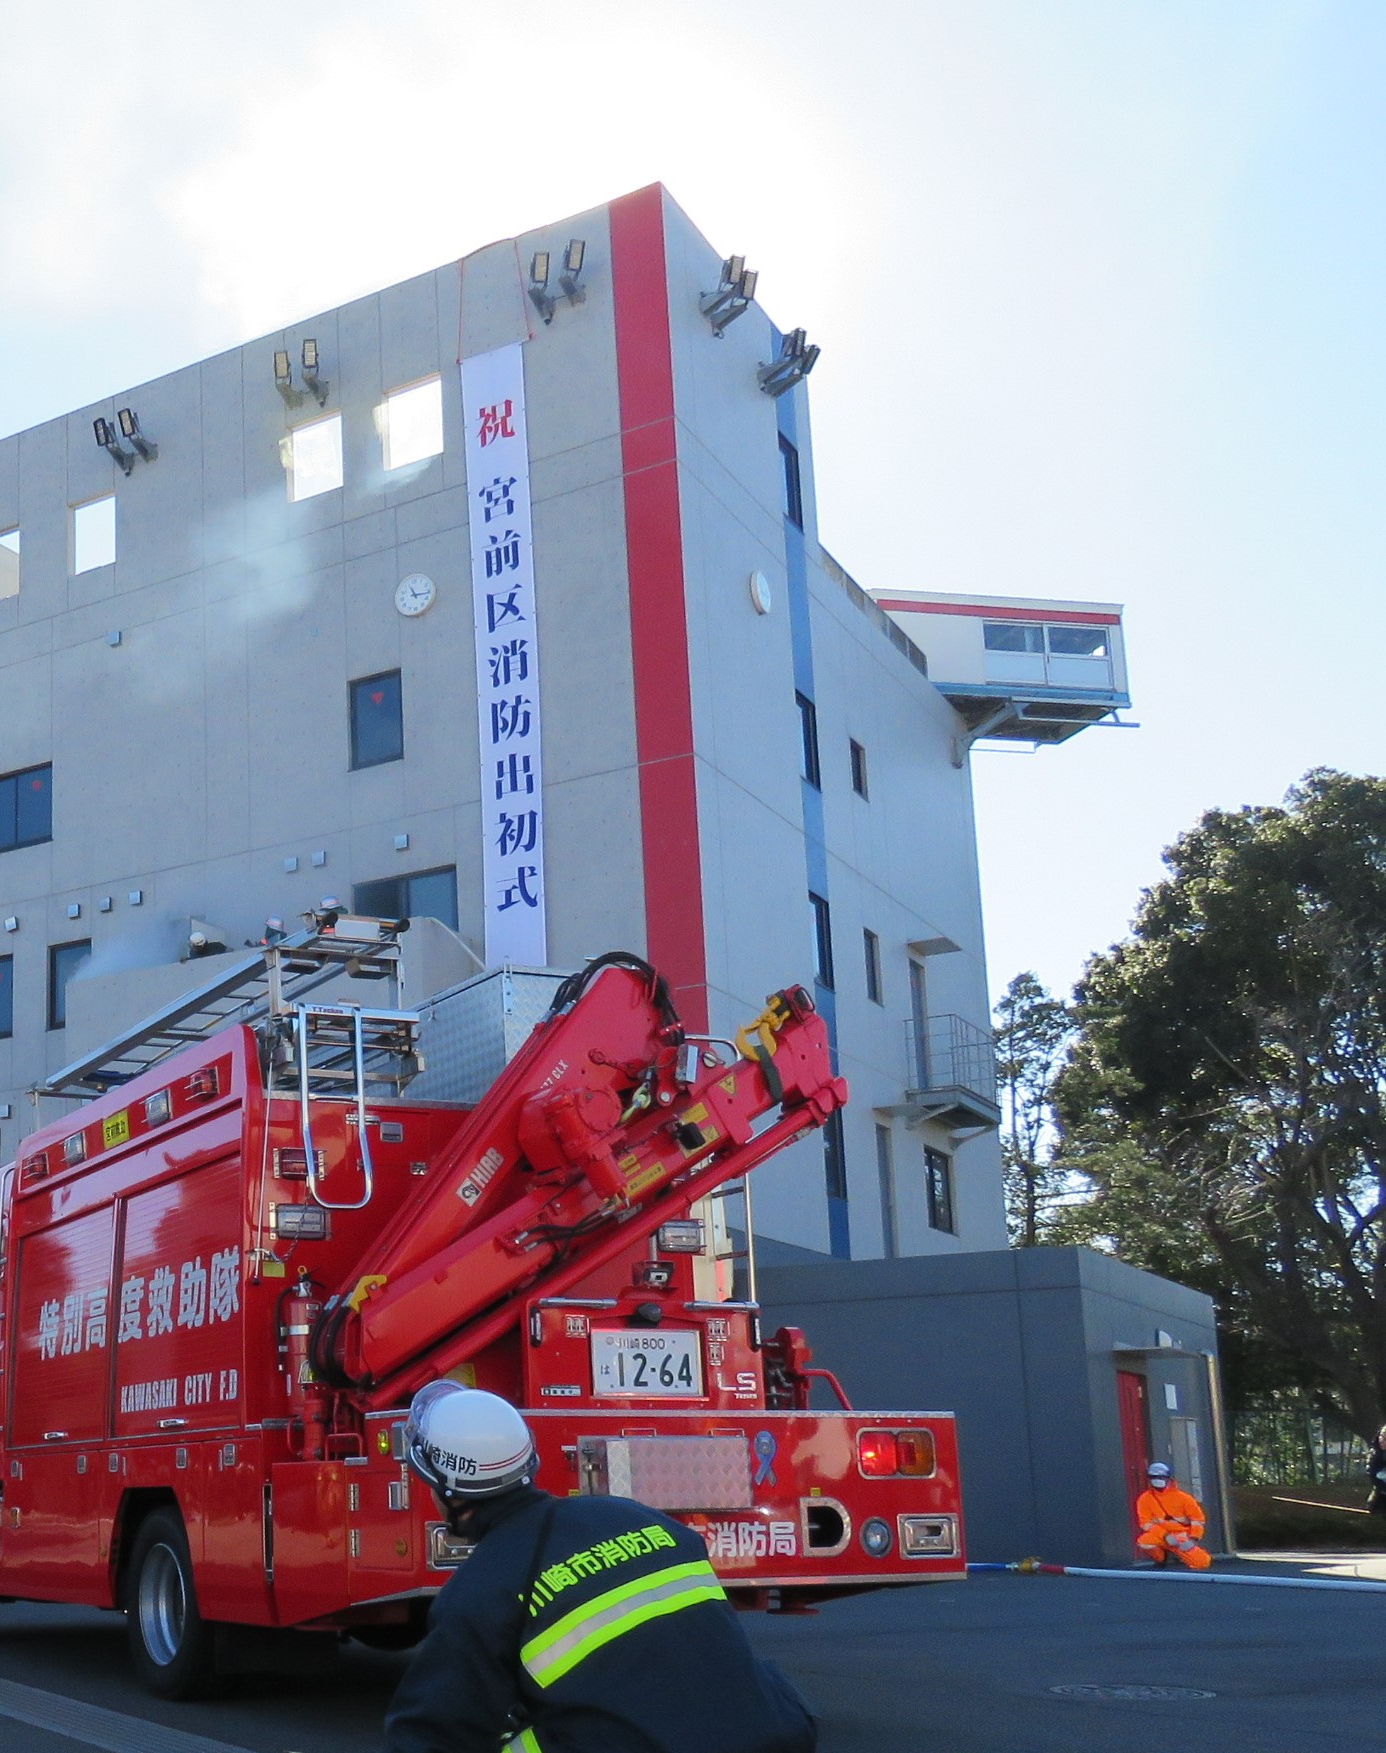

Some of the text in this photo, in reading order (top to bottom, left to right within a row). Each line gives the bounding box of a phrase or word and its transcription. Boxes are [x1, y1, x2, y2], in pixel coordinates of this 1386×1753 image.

[476, 399, 539, 912] 祝 宮前区消防出初式
[470, 1147, 505, 1188] HIAB
[38, 1244, 240, 1361] 特別高度救助隊
[618, 1352, 692, 1387] 12-64
[716, 1372, 757, 1392] LS
[120, 1378, 177, 1413] KAWASAKI
[184, 1372, 213, 1406] CITY
[518, 1524, 677, 1617] 川崎市消防局
